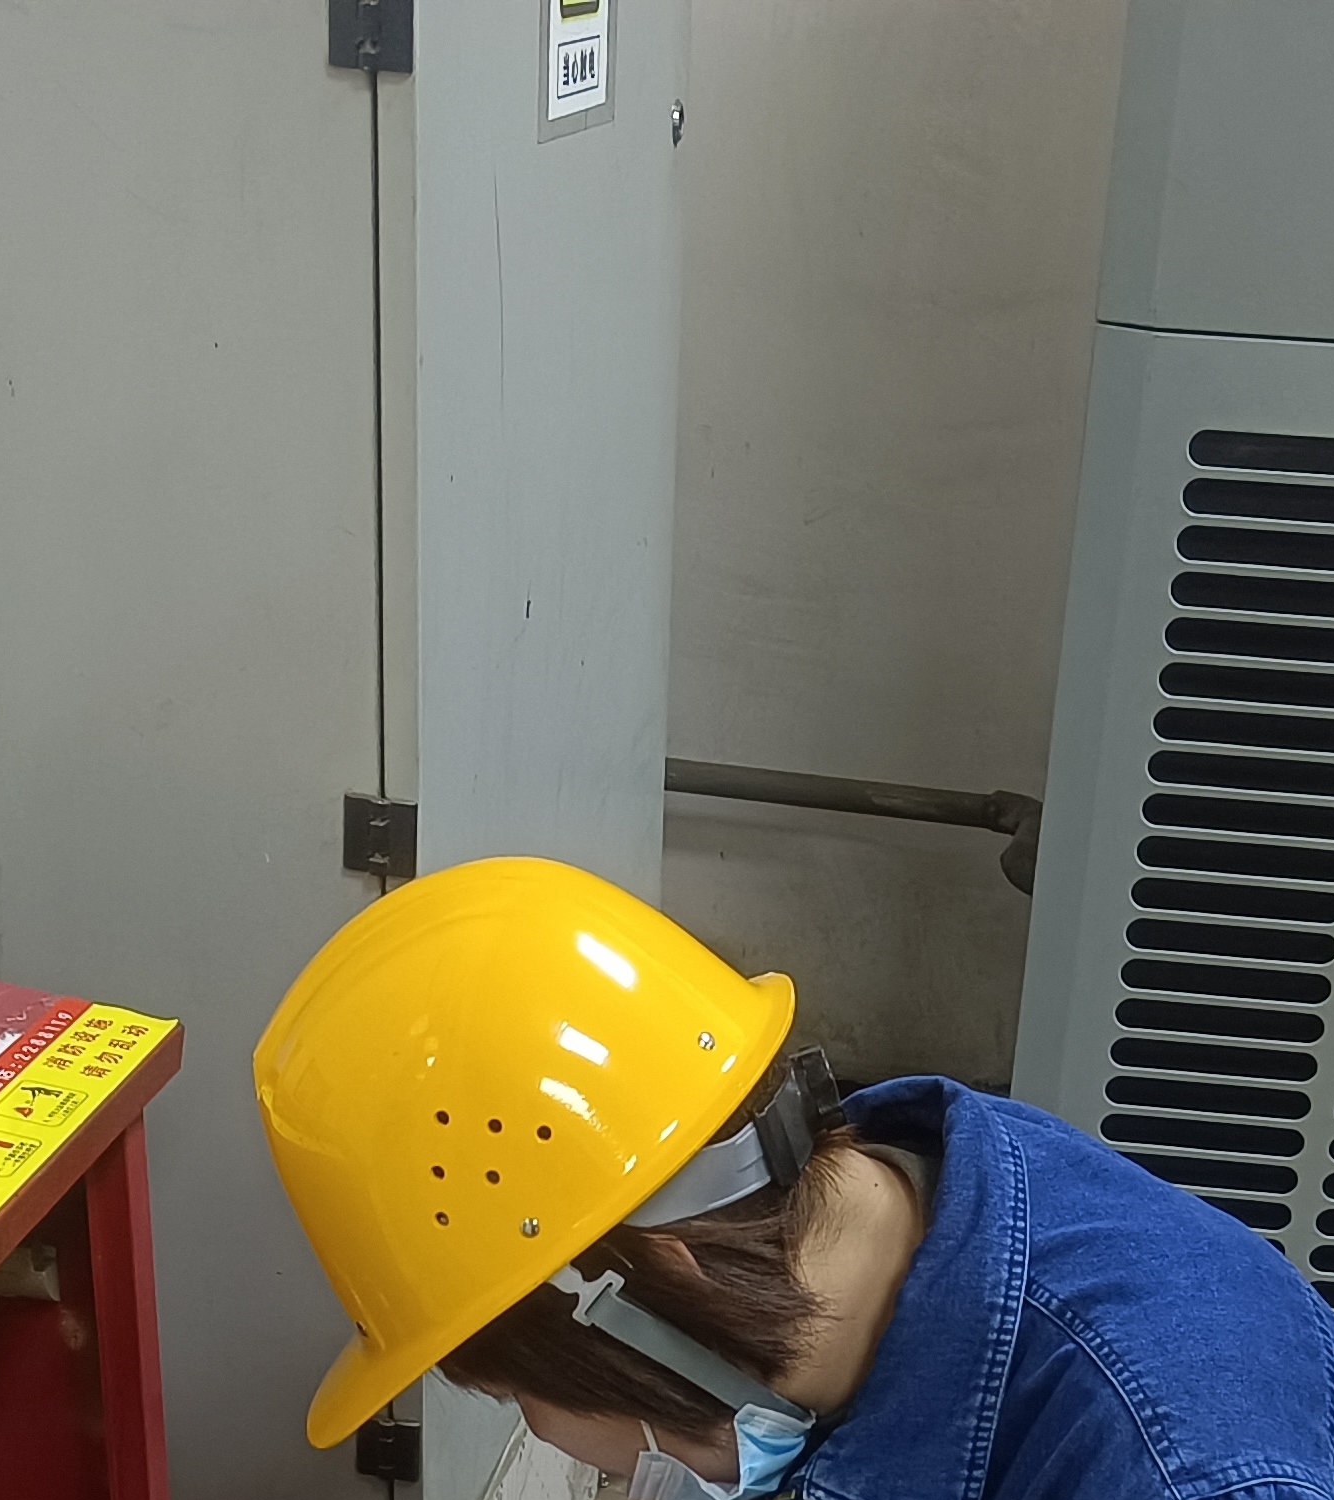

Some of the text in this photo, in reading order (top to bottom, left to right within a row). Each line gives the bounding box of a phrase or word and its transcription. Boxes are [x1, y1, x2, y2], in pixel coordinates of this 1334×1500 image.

[43, 1018, 114, 1071] 消防设施
[79, 1024, 149, 1079] 请勿乱动
